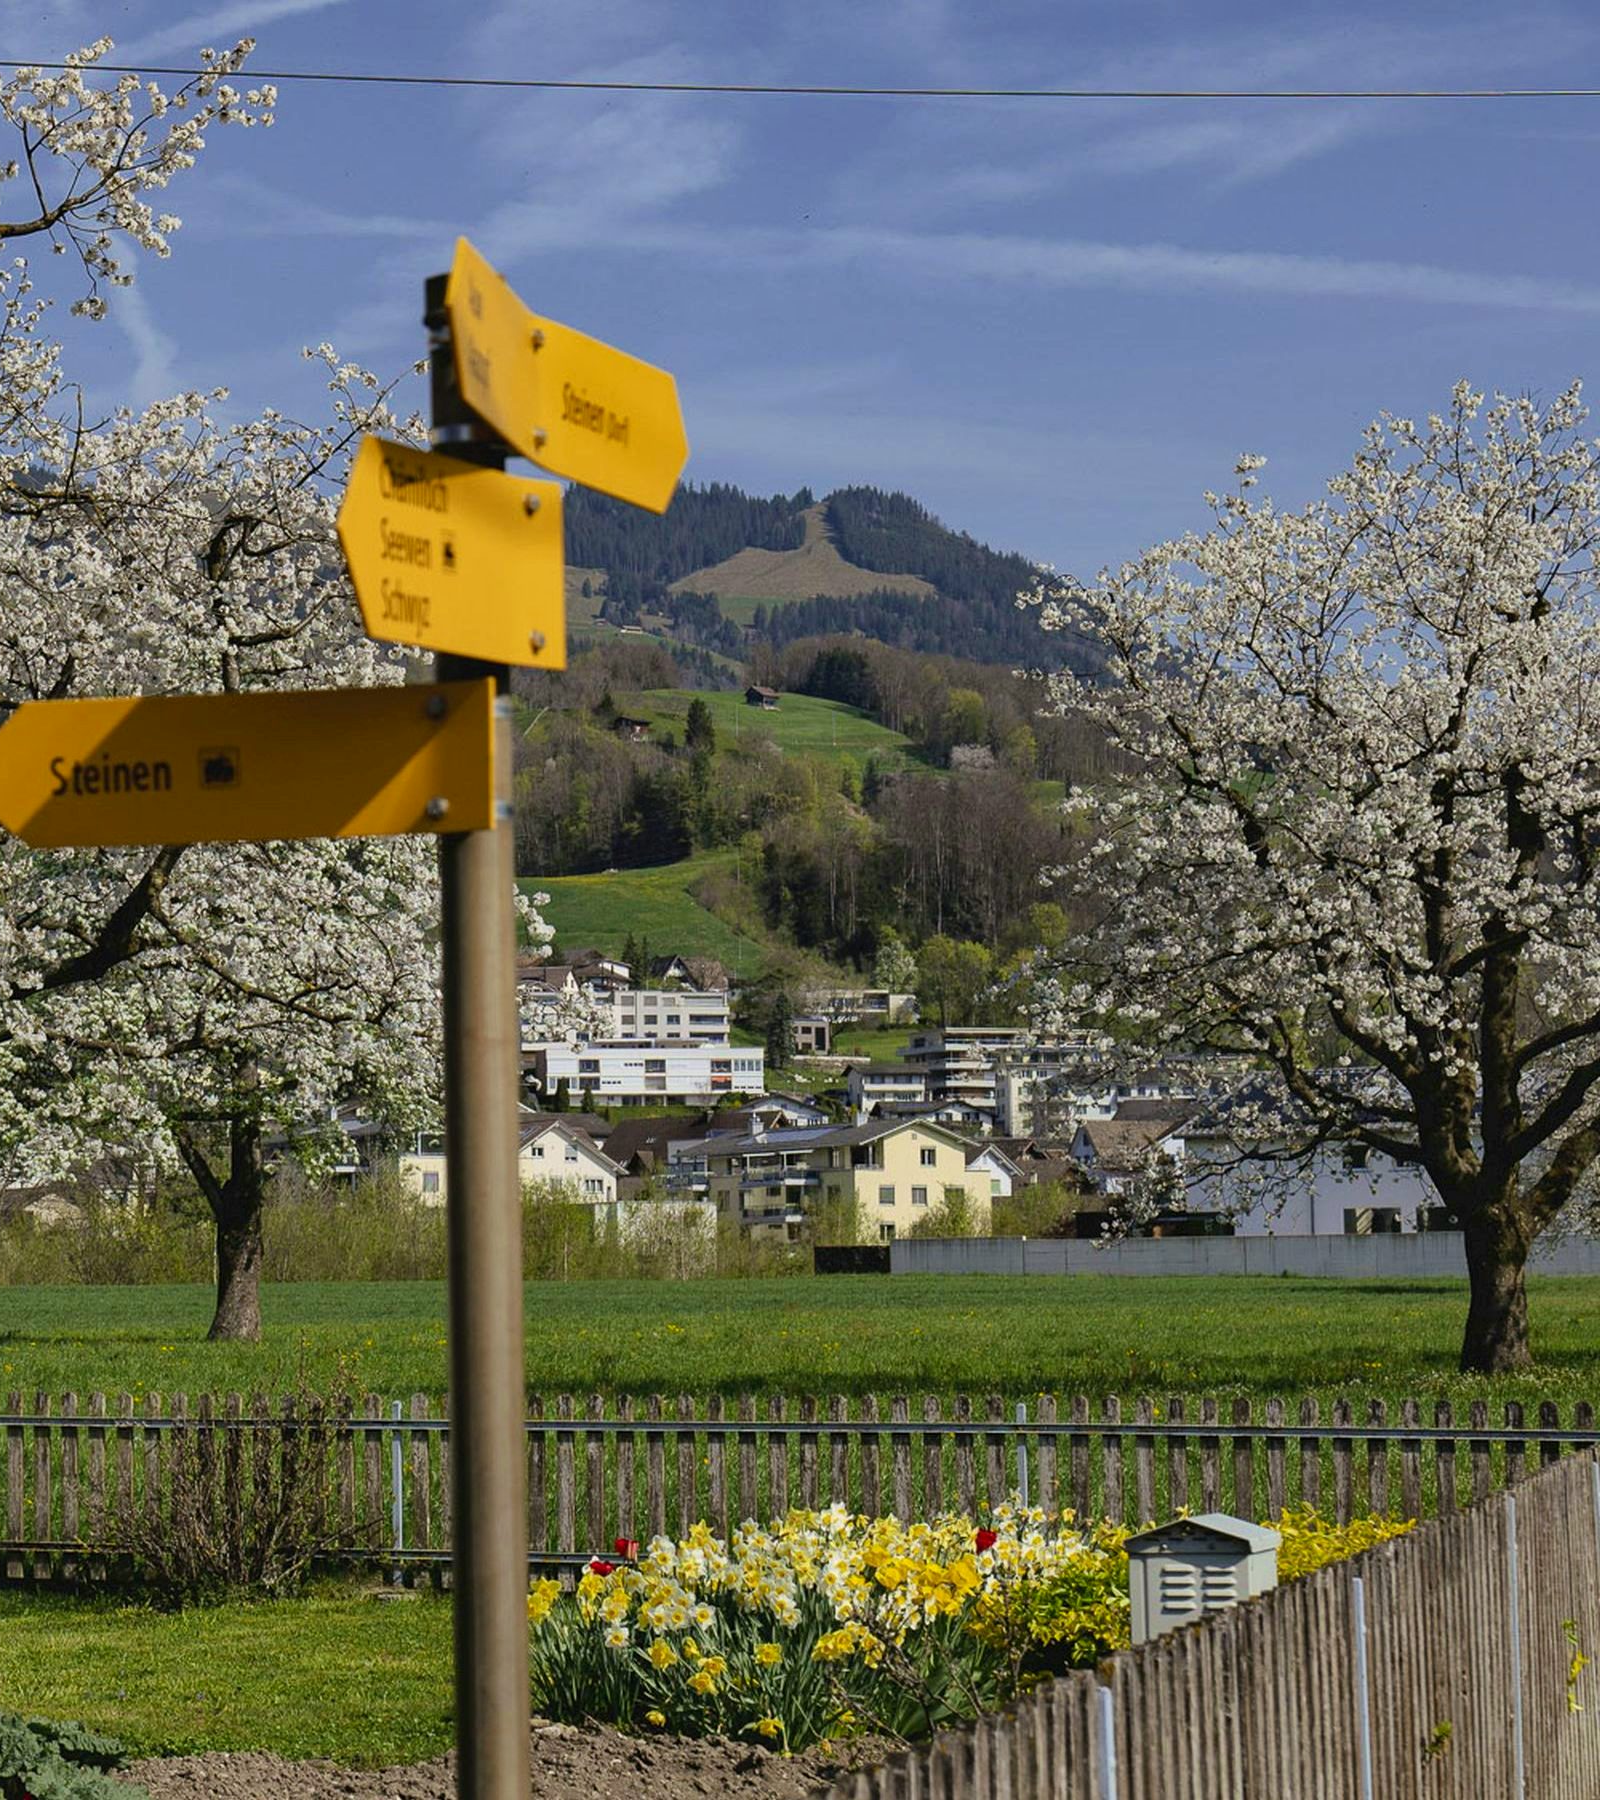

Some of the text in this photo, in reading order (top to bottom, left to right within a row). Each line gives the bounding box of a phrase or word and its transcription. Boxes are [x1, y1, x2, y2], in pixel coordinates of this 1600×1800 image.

[562, 382, 604, 434] Steinen
[380, 516, 431, 569] Seewen
[381, 577, 430, 638] Schwyz
[51, 754, 173, 797] Steinen
